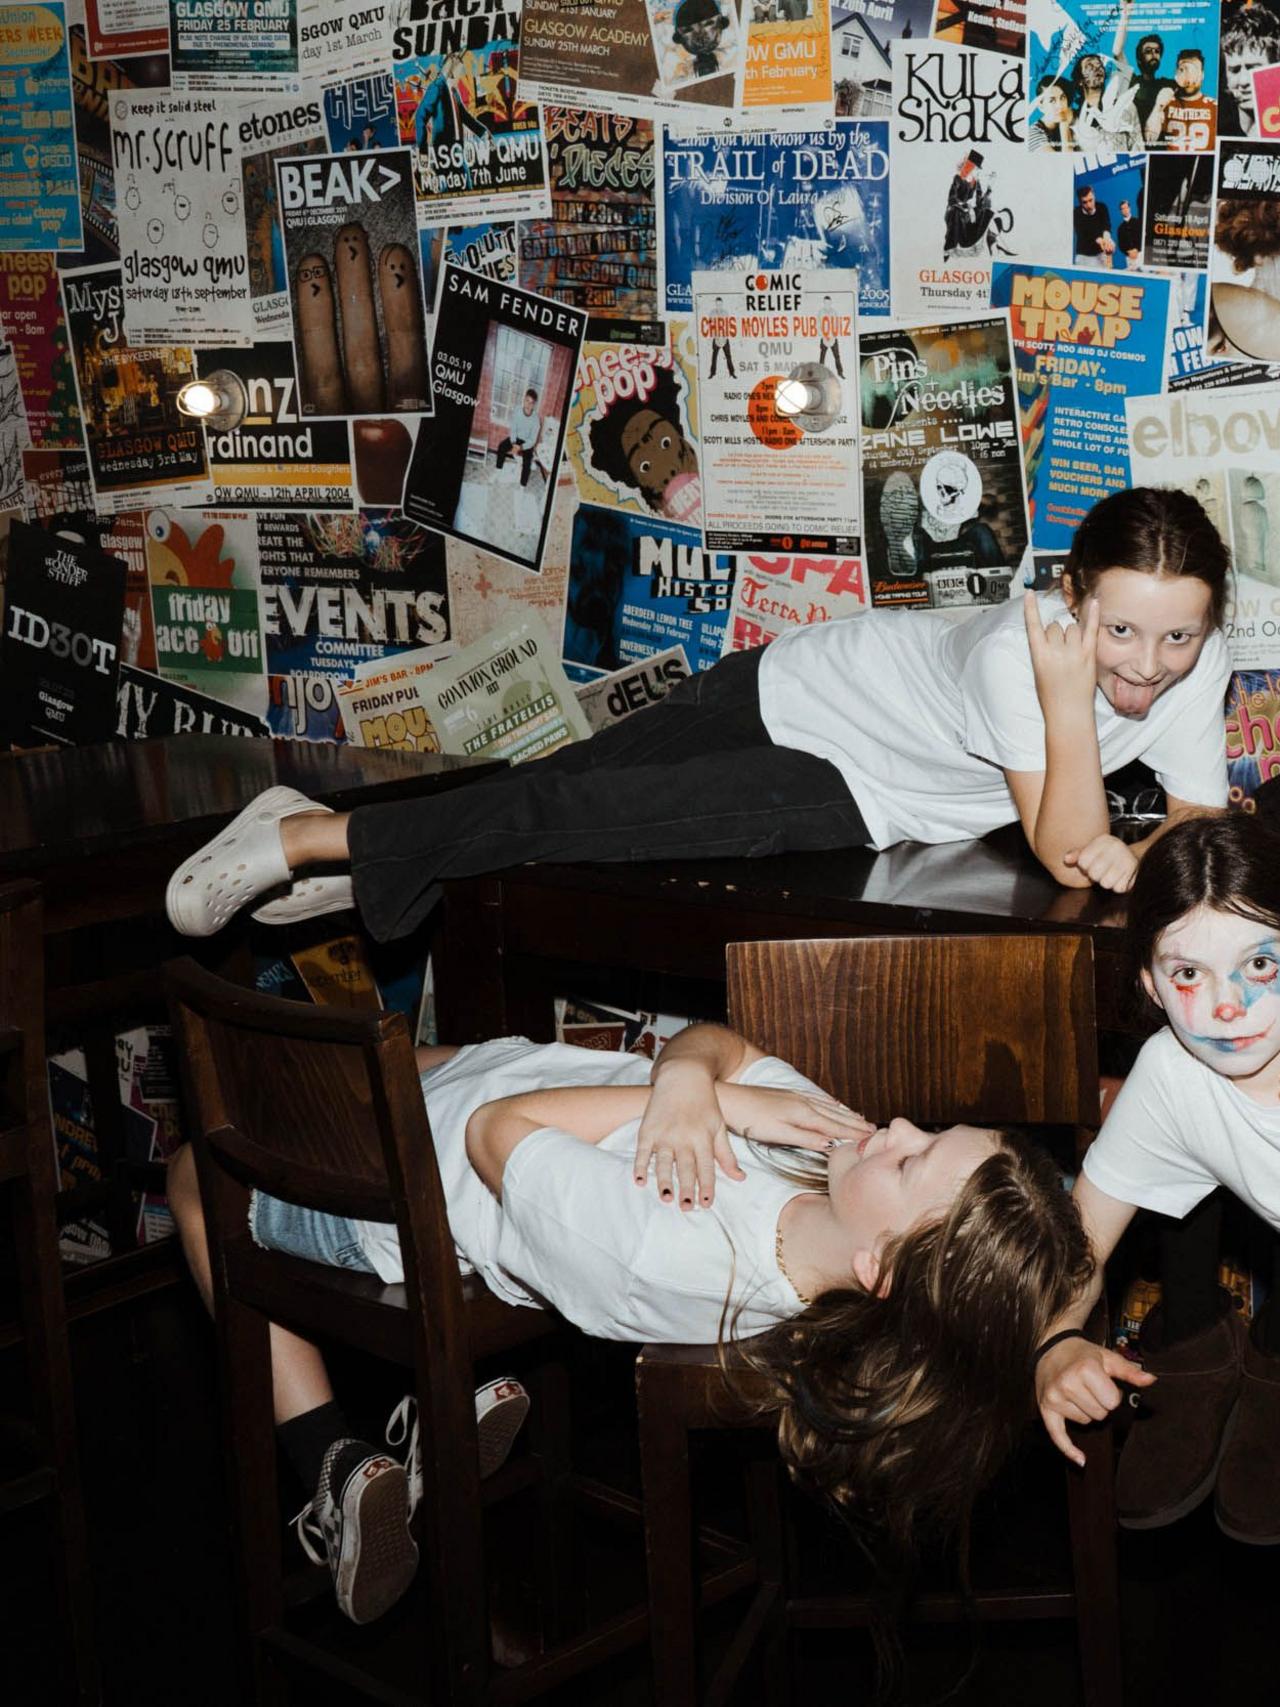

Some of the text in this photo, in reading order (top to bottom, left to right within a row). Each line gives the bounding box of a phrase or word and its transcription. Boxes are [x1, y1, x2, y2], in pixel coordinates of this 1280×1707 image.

[176, 0, 250, 18] GLASGOW
[253, 0, 290, 17] QMU
[580, 5, 617, 20] JANUARY
[177, 18, 290, 32] FRIDAY 25 FEBRUARY
[301, 5, 386, 42] SGOW QMU
[524, 19, 650, 47] GLASGOW ACADEMY
[392, 12, 520, 62] SUNDAY
[523, 36, 610, 57] SUNDAY 25TH MARCH
[156, 102, 168, 114] it
[168, 101, 192, 113] solid
[193, 99, 217, 112] steel
[238, 102, 322, 143] etones
[496, 133, 540, 162] QMU
[768, 130, 807, 149] know
[809, 132, 825, 147] us
[826, 130, 847, 151] by
[847, 128, 871, 147] the
[665, 150, 891, 182] TRAIL of DEAD
[420, 161, 528, 196] Monday 7th June
[123, 250, 246, 284] glasgow qmu
[125, 286, 248, 302] saturday 18th september
[745, 273, 802, 292] COMIC
[920, 286, 973, 301] Thursday
[447, 274, 580, 339] SAM FENDER
[745, 295, 802, 313] RELIEF
[1012, 272, 1144, 322] MOUSE
[701, 316, 738, 339] CHRIS
[740, 316, 789, 339] MOYLES
[791, 316, 819, 338] PUB
[820, 316, 852, 338] QUIZ
[1020, 307, 1132, 348] TRAP
[436, 350, 473, 373] 03.05.19
[758, 341, 794, 358] QMU
[434, 363, 467, 387] QMU
[873, 352, 929, 392] Pins
[432, 379, 481, 408] Glasgow
[595, 360, 657, 417] pop
[901, 380, 1007, 418] Needles
[1054, 405, 1110, 420] INTERACTIVE
[861, 420, 1015, 453] ZANE LOWE
[1053, 427, 1111, 443] GREAT TUNES
[235, 486, 350, 501] QMU 12th APRIL 2004
[99, 533, 144, 550] Glasgow
[56, 550, 79, 565] THE
[45, 557, 89, 583] WONDER
[48, 567, 83, 588] STUFF
[304, 569, 360, 581] REMEMBERS
[167, 592, 232, 625] friday
[260, 582, 449, 645] EVENTS
[226, 627, 260, 660] off
[315, 640, 385, 658] COMMITTEE
[364, 662, 434, 689] JIM'S BAR 8PM
[437, 637, 539, 713] COMMON GROUND
[39, 691, 75, 713] Glasgow
[351, 692, 394, 715] FRIDAY
[463, 693, 556, 756] THE FRATELLIS
